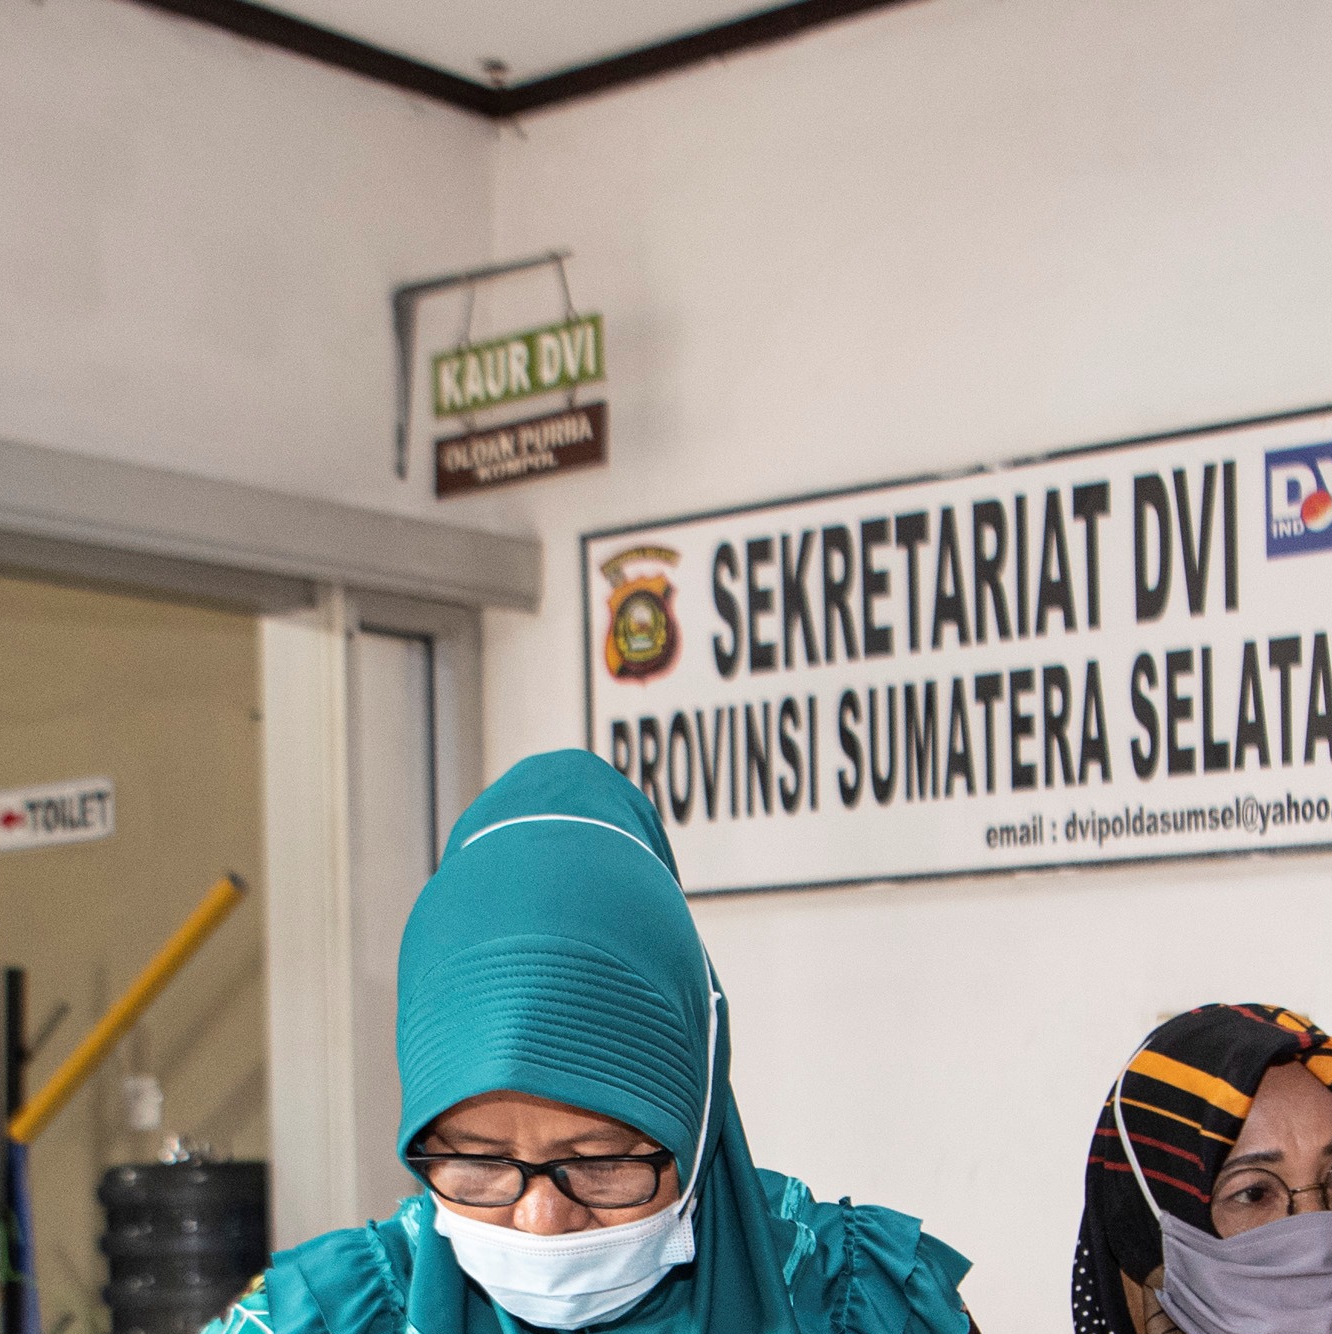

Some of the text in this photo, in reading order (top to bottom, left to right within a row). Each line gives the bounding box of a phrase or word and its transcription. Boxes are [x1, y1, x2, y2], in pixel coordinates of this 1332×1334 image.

[439, 322, 596, 410] KAUR DVI
[709, 460, 1240, 680] SEKRETARIAT DVI
[611, 693, 820, 826] PROVINSI
[837, 658, 1113, 806] SUMATERA
[26, 788, 112, 833] TOILET
[985, 814, 1045, 850] email
